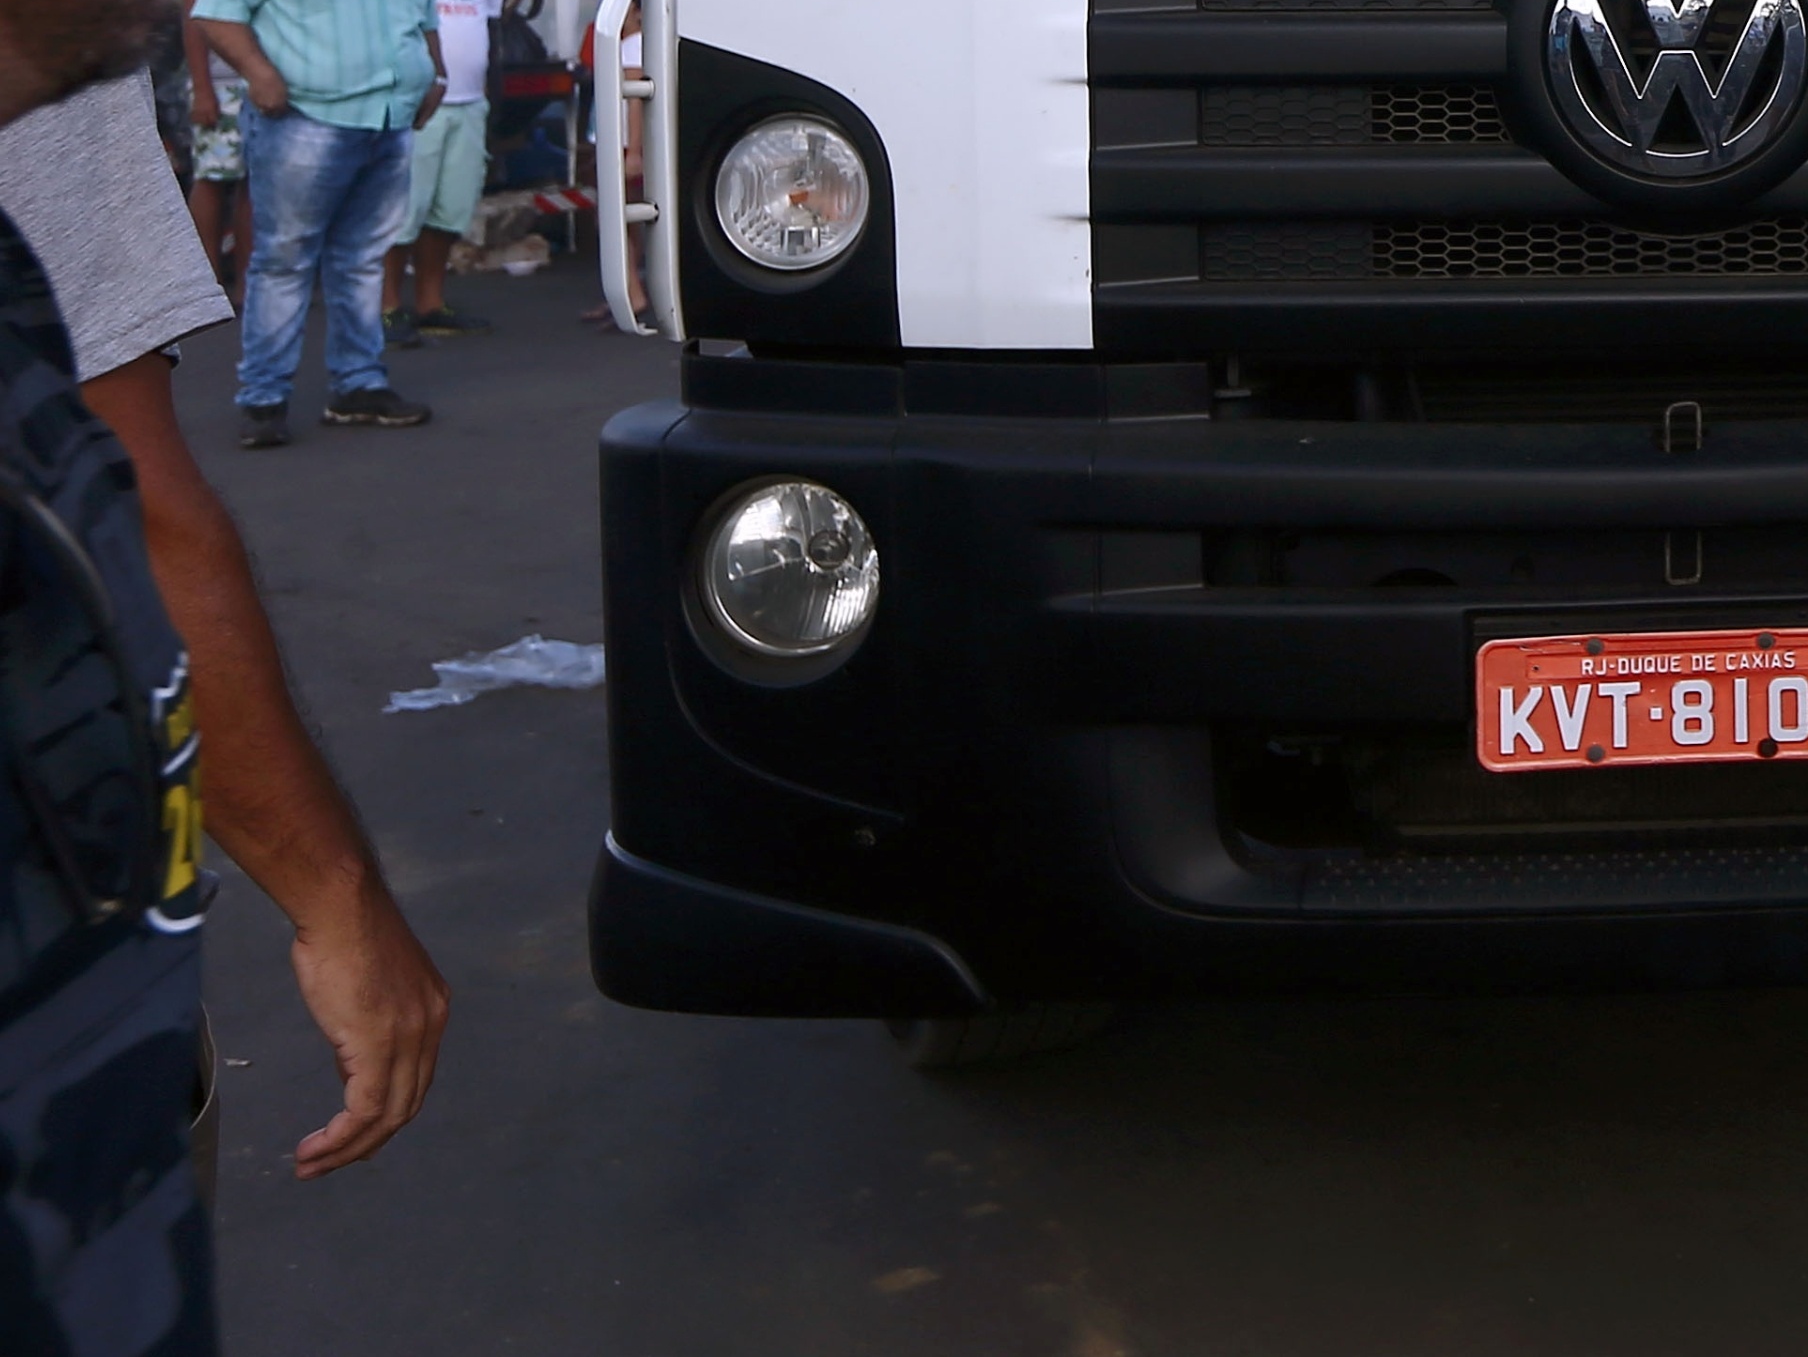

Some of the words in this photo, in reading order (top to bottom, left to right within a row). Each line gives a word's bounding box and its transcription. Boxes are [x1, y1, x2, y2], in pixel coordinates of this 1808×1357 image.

[1581, 655, 1682, 676] RJ-DUQUE
[1691, 654, 1717, 672] DE
[1725, 651, 1796, 672] CAXIAS
